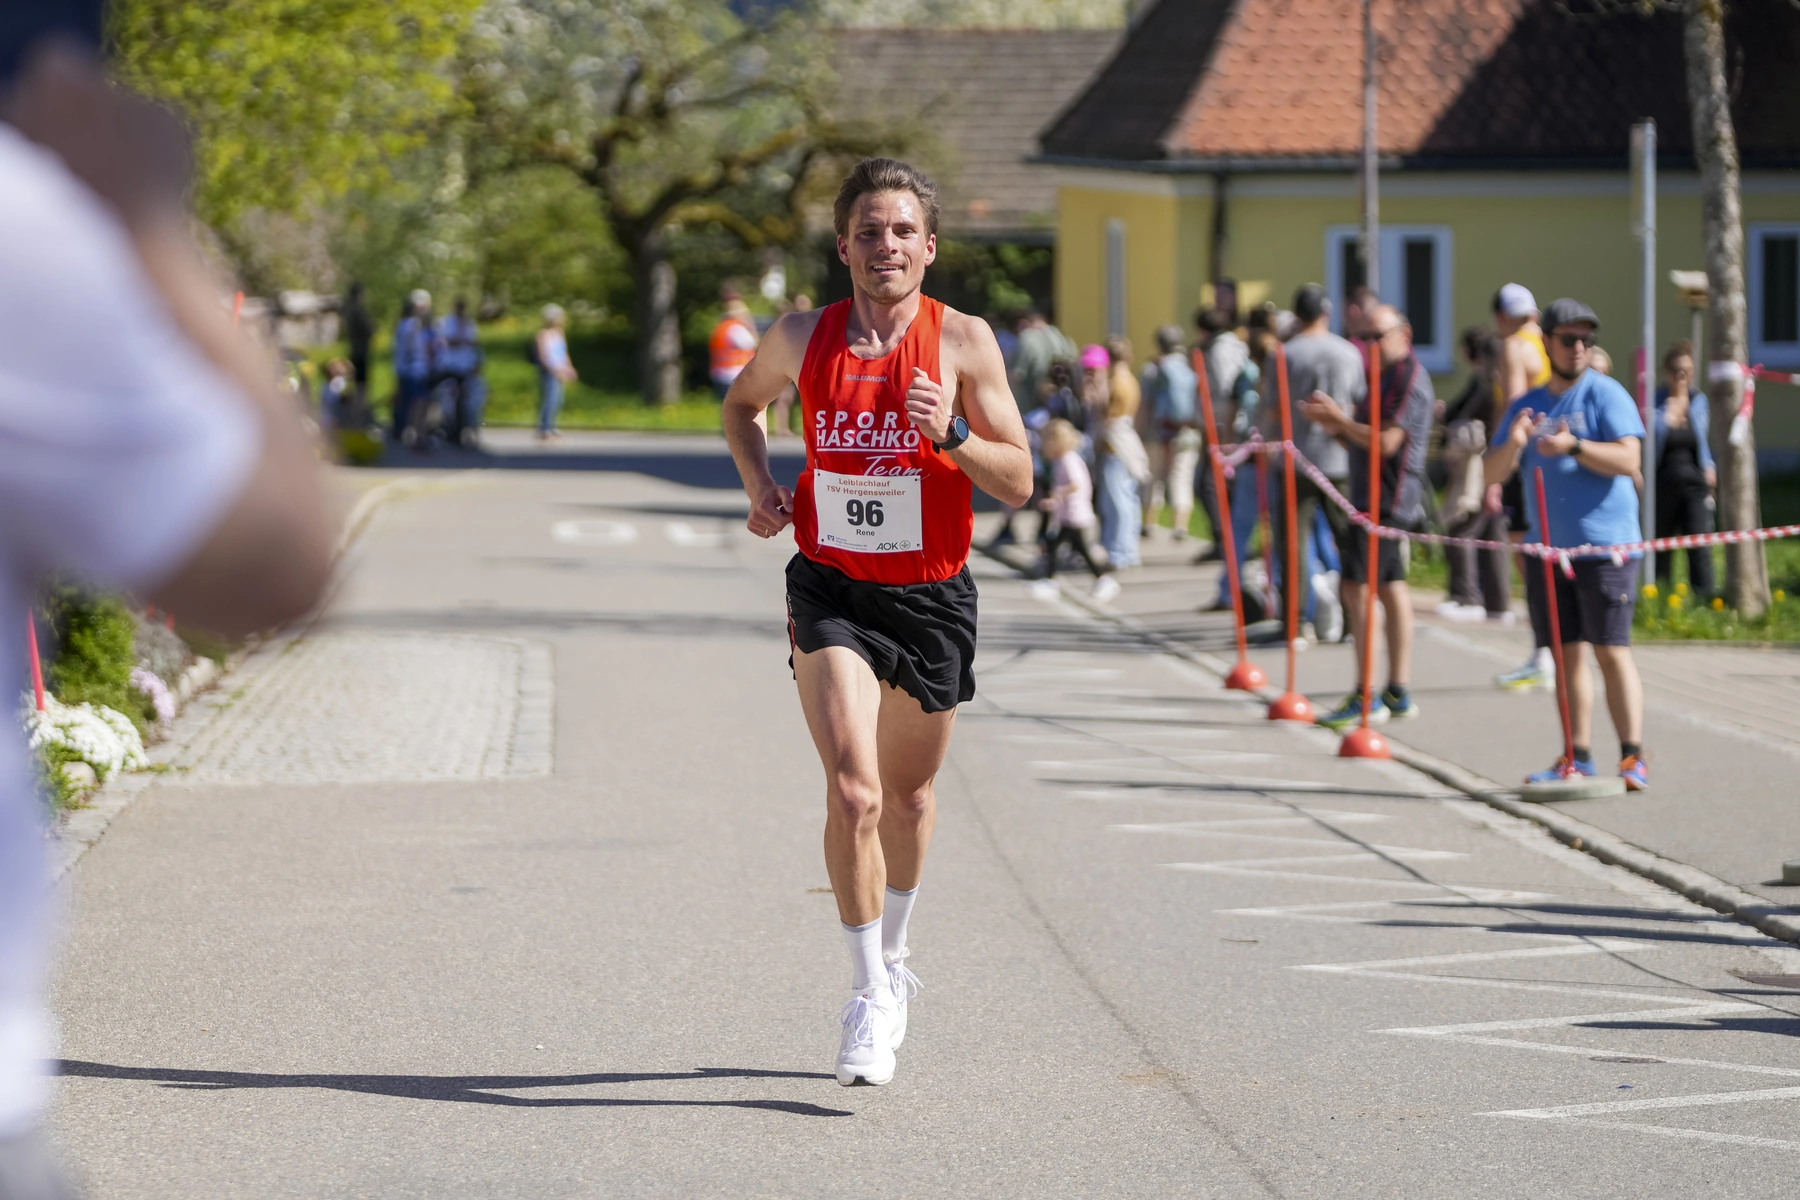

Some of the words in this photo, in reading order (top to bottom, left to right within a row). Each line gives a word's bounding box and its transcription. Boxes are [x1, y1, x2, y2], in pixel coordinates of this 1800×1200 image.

[845, 373, 887, 383] SALOMON
[815, 410, 917, 429] SPOR
[816, 429, 920, 448] HASCHKO
[864, 455, 923, 476] Team
[838, 478, 891, 487] Leiblachlauf
[826, 485, 841, 493] TSV
[843, 488, 906, 497] Hergensweiler
[846, 499, 884, 527] 96
[856, 529, 875, 537] Rene
[876, 542, 899, 551] AOK
